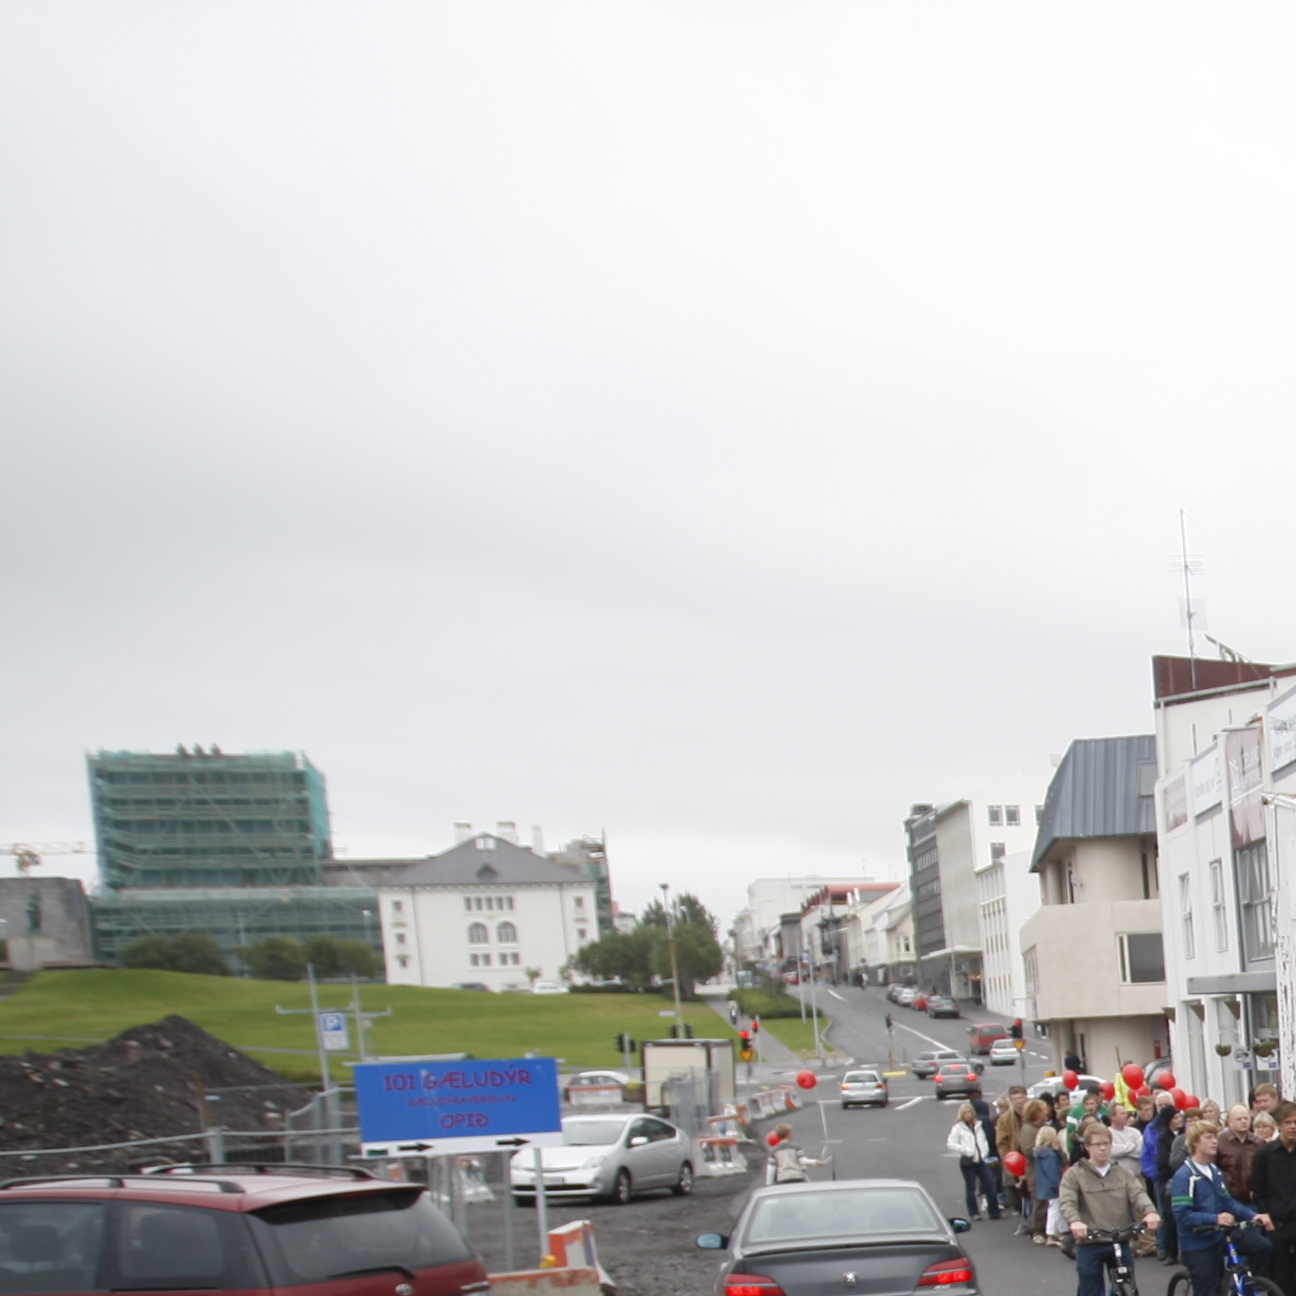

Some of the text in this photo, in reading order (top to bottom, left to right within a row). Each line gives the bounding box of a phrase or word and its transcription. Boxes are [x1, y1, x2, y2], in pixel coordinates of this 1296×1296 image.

[383, 1064, 532, 1091] 101 GÆLUDÝR
[439, 1113, 489, 1129] OPIÐ
